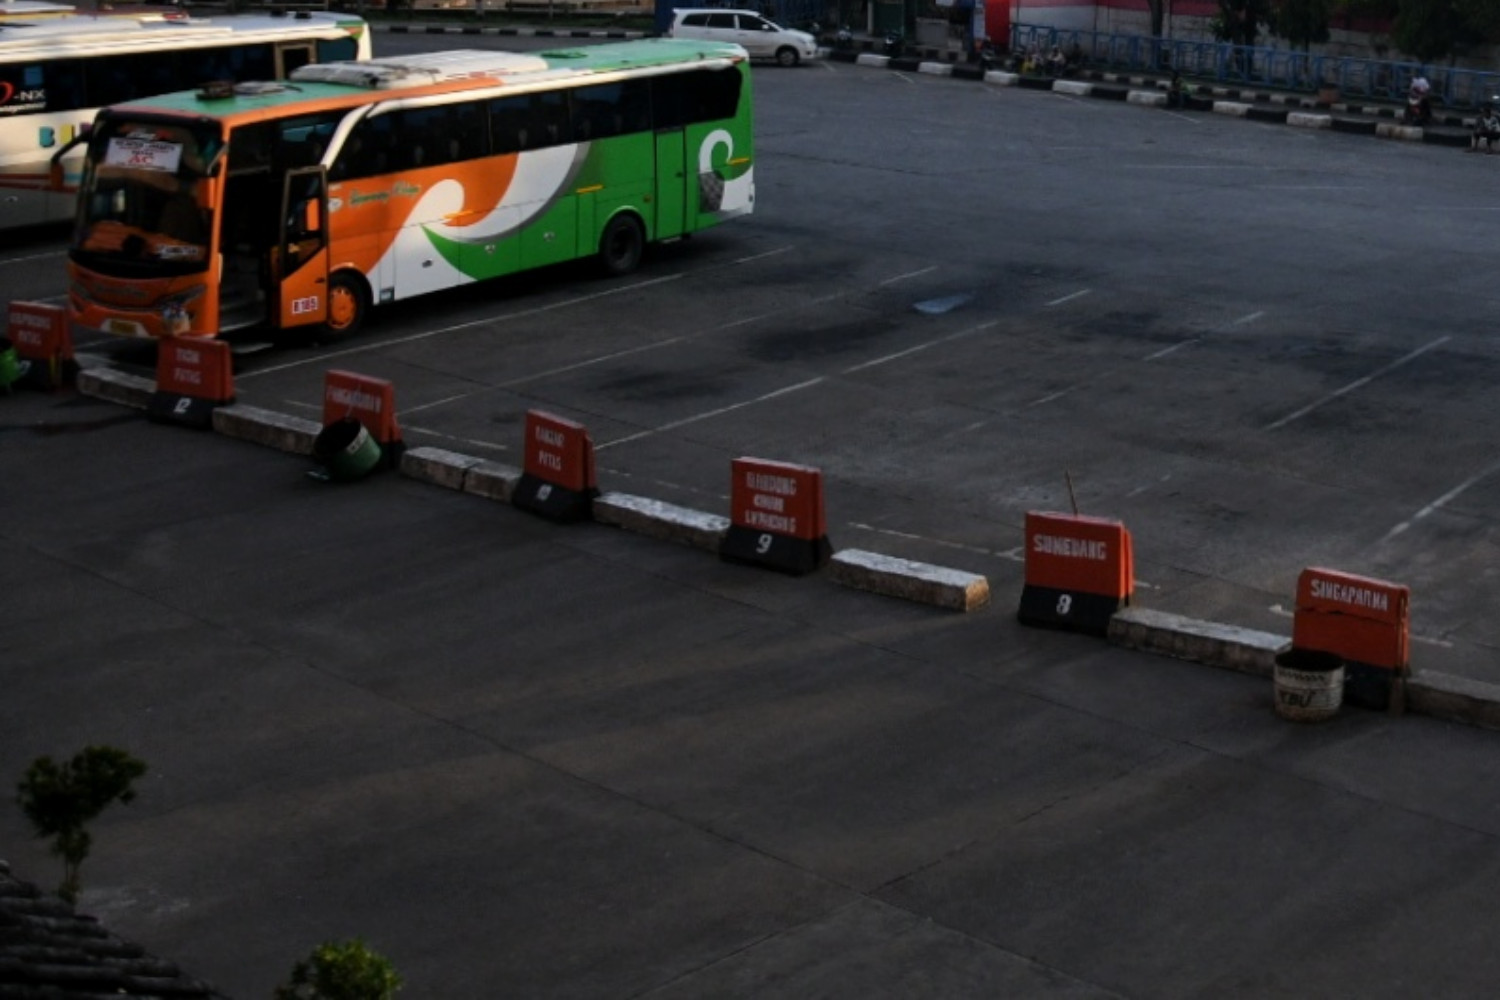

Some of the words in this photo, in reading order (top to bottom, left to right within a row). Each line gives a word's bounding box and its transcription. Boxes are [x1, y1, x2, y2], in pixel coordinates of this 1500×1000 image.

[756, 533, 773, 555] 9
[1032, 534, 1107, 561] SUMEDANG
[1055, 593, 1073, 616] 8
[1309, 577, 1389, 612] SINGAPARNA
